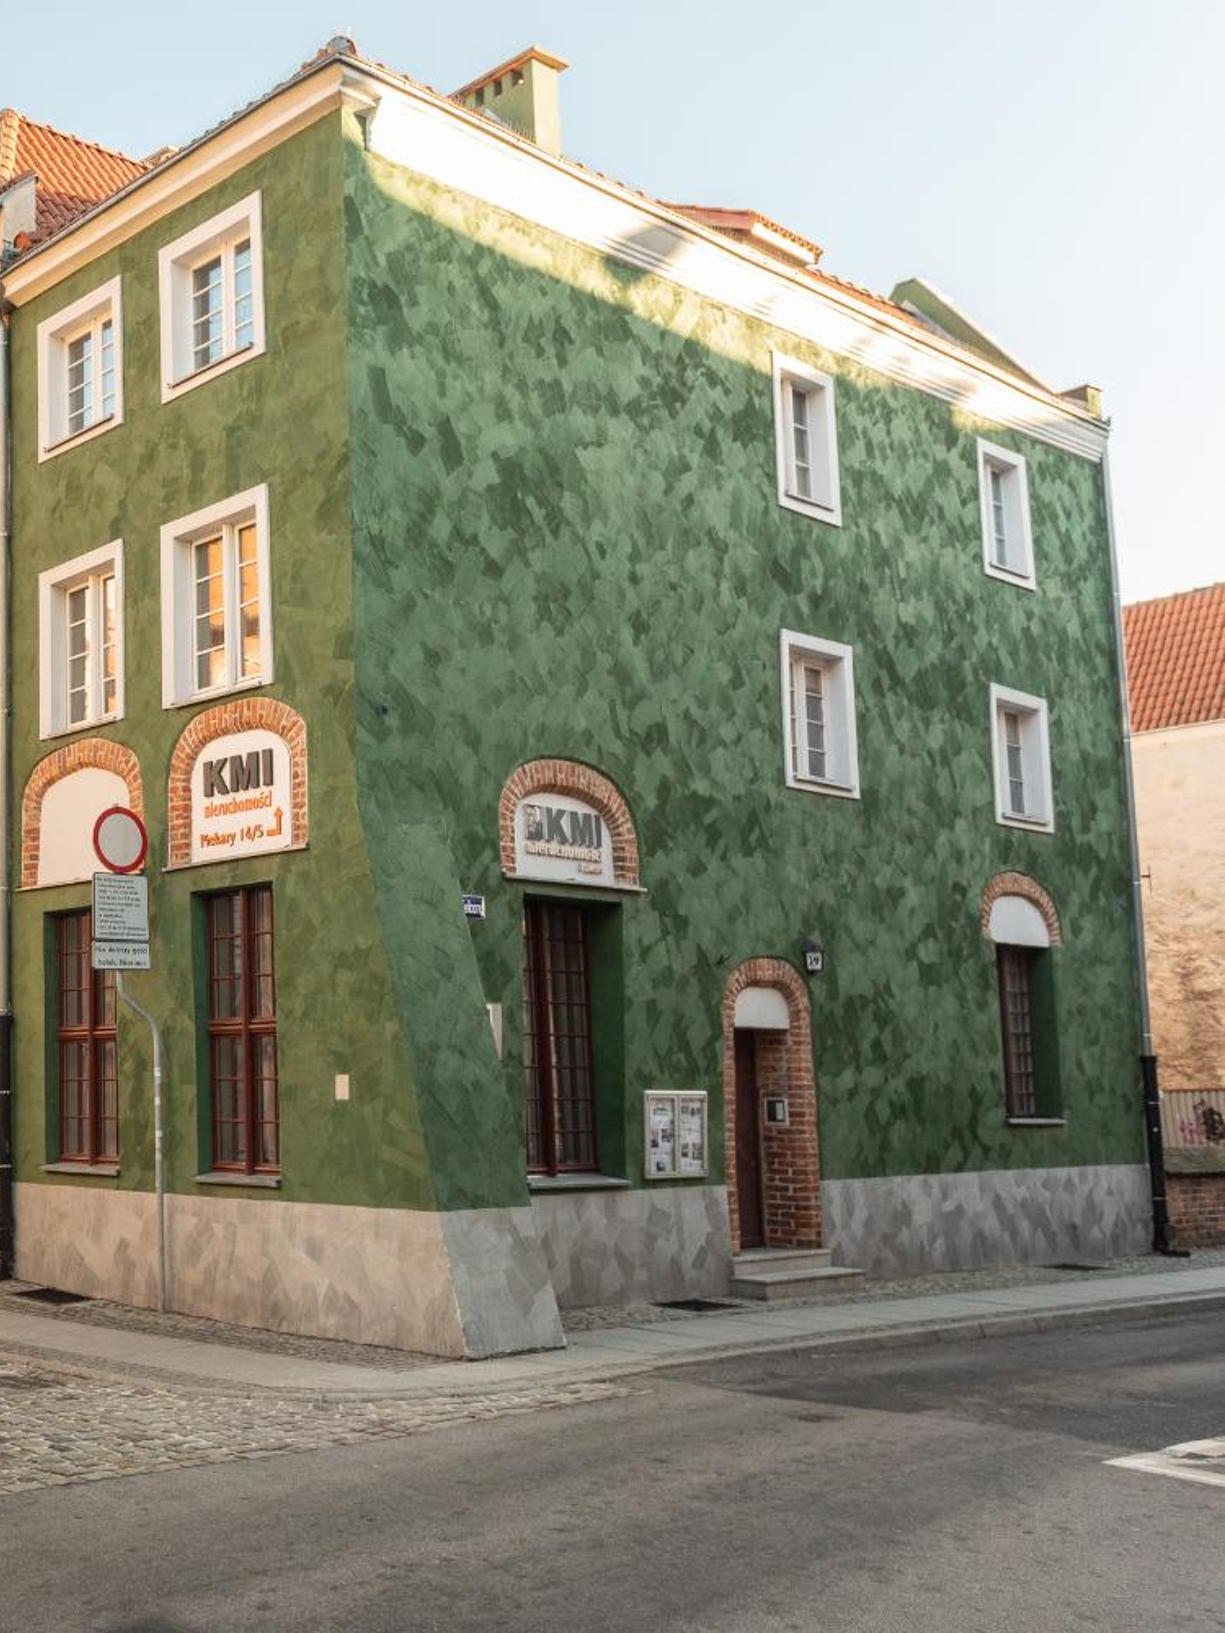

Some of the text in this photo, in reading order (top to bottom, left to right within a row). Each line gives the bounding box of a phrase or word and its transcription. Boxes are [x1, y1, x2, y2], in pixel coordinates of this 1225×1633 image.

[202, 748, 274, 798] KMI
[204, 791, 272, 818] nieruchomości
[545, 806, 603, 850] KMI
